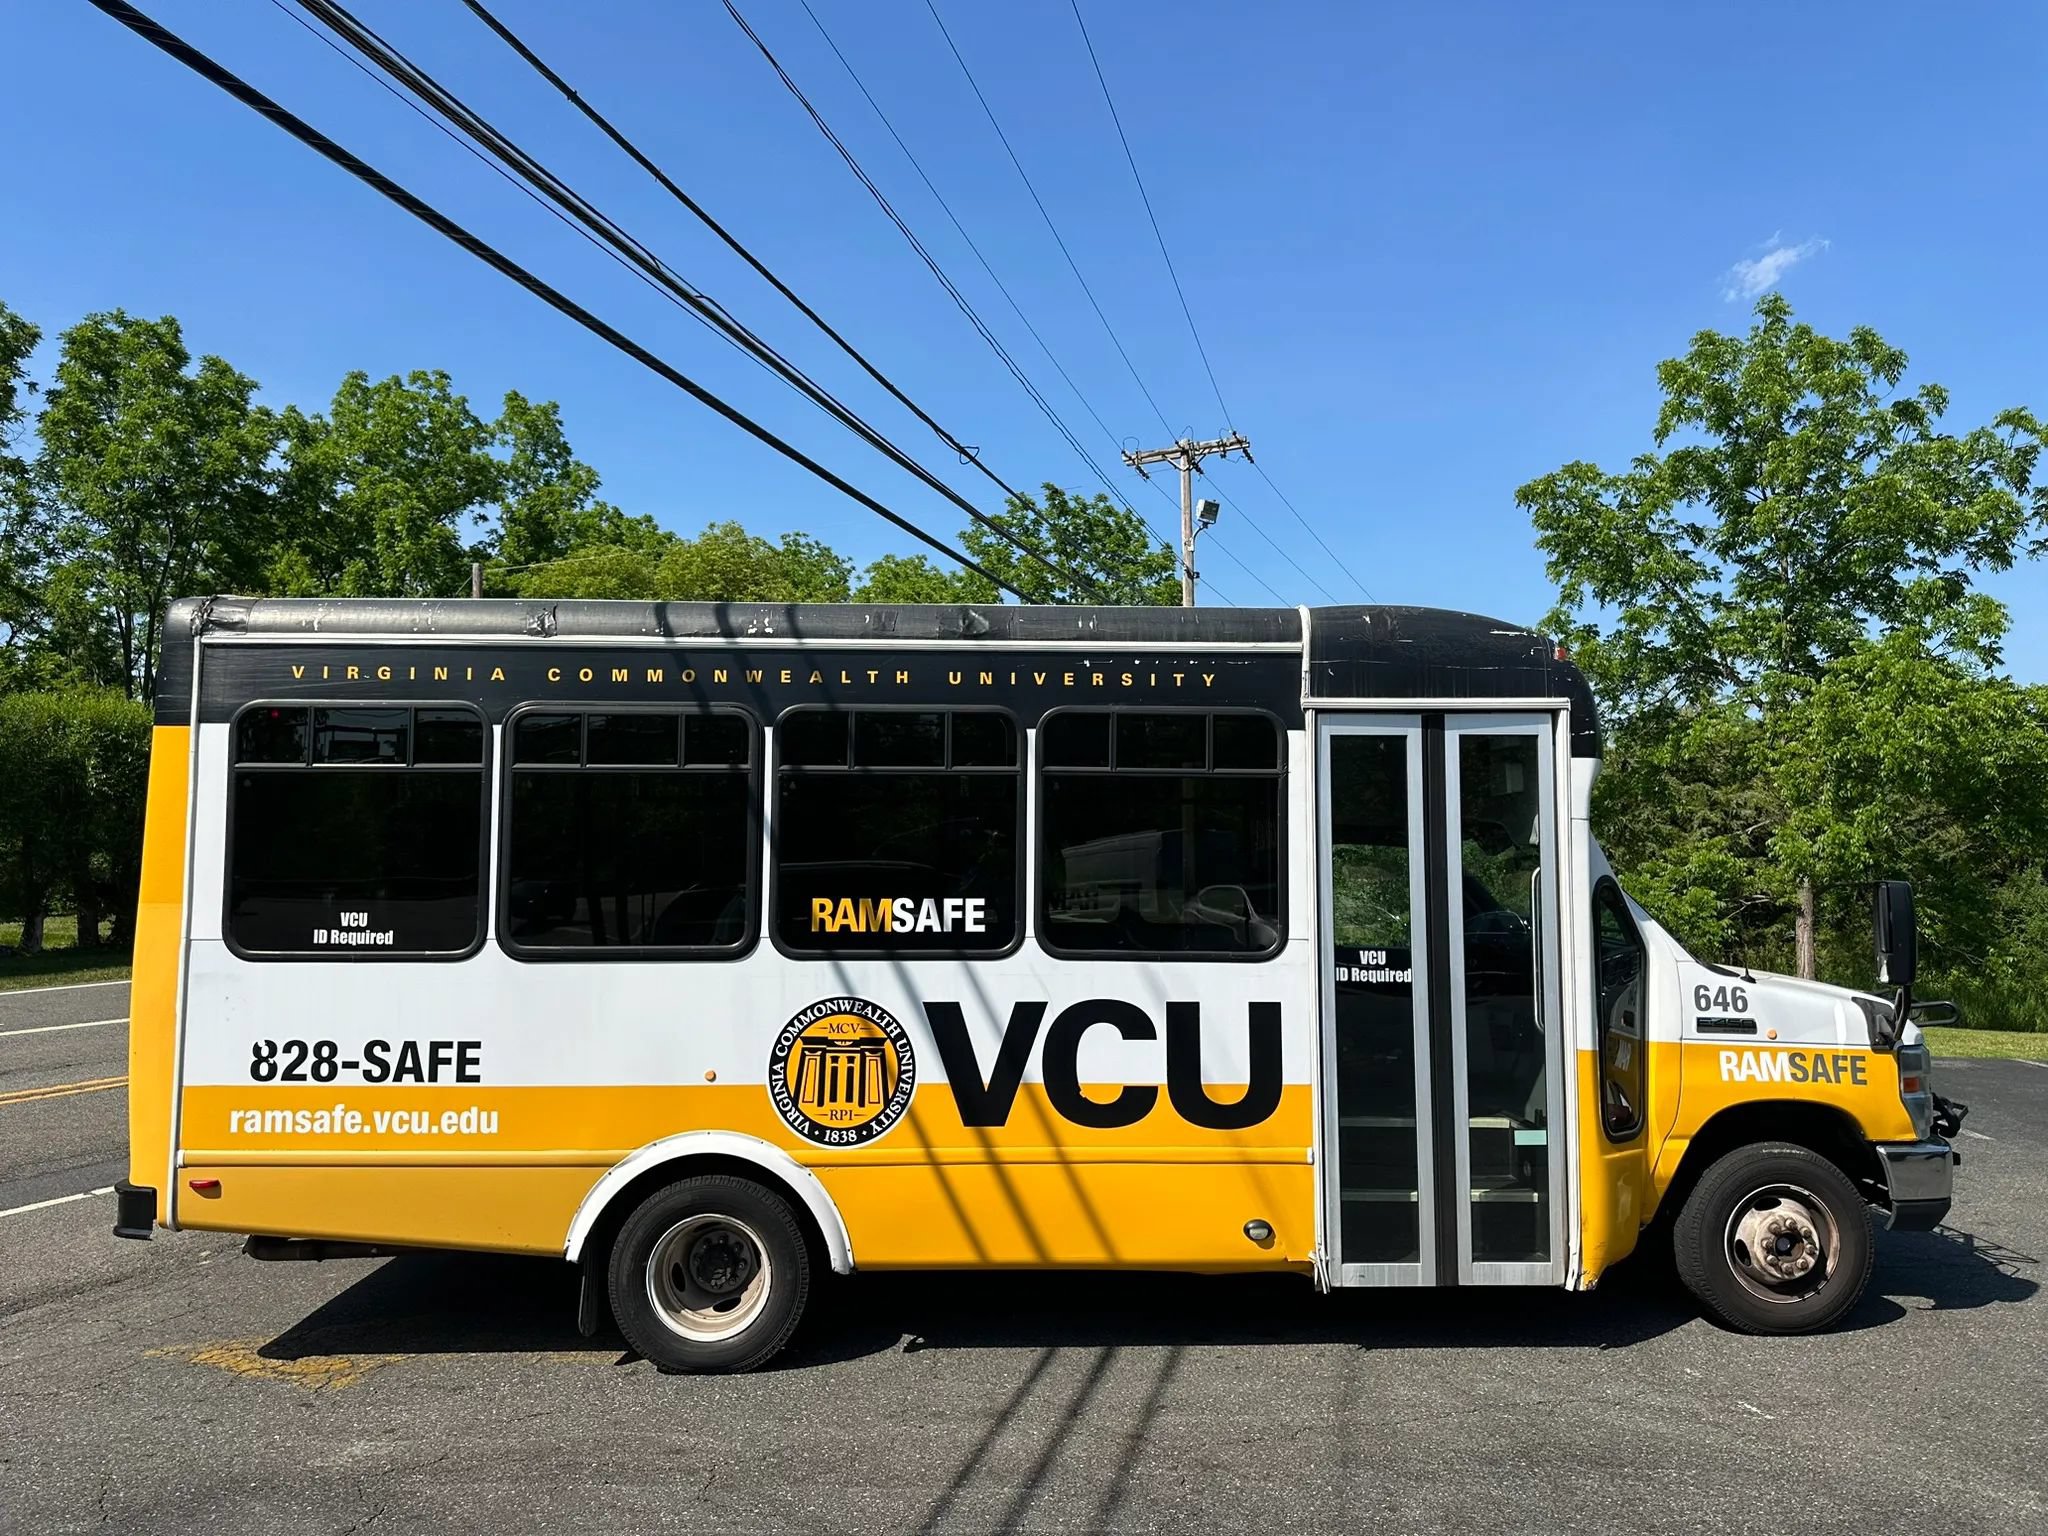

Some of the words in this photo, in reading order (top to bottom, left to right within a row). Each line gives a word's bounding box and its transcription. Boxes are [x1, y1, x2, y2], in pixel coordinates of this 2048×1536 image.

[291, 664, 505, 682] VIRGINIA
[547, 667, 909, 685] COMMONWEALTH
[948, 670, 1216, 687] UNIVERSITY
[340, 911, 368, 927] VCU
[811, 897, 986, 933] RAMSAFE
[313, 929, 328, 944] ID
[330, 929, 393, 946] Required
[1359, 950, 1386, 965] VCU
[1336, 967, 1348, 981] ID
[1351, 967, 1412, 983] Required
[1694, 984, 1748, 1013] 646
[775, 999, 902, 1058] COMMONWEALTH
[828, 1023, 861, 1034] MCV
[250, 1039, 482, 1083] 828-SAFE
[922, 998, 1284, 1131] VCU
[1719, 1050, 1868, 1086] RAMSAFE
[772, 1061, 811, 1135] VIRGINIA
[870, 1037, 914, 1135] UNIVERSITY
[229, 1104, 499, 1134] ramsafe.vcu.edu
[829, 1109, 854, 1121] RPI
[823, 1129, 858, 1143] 1838
